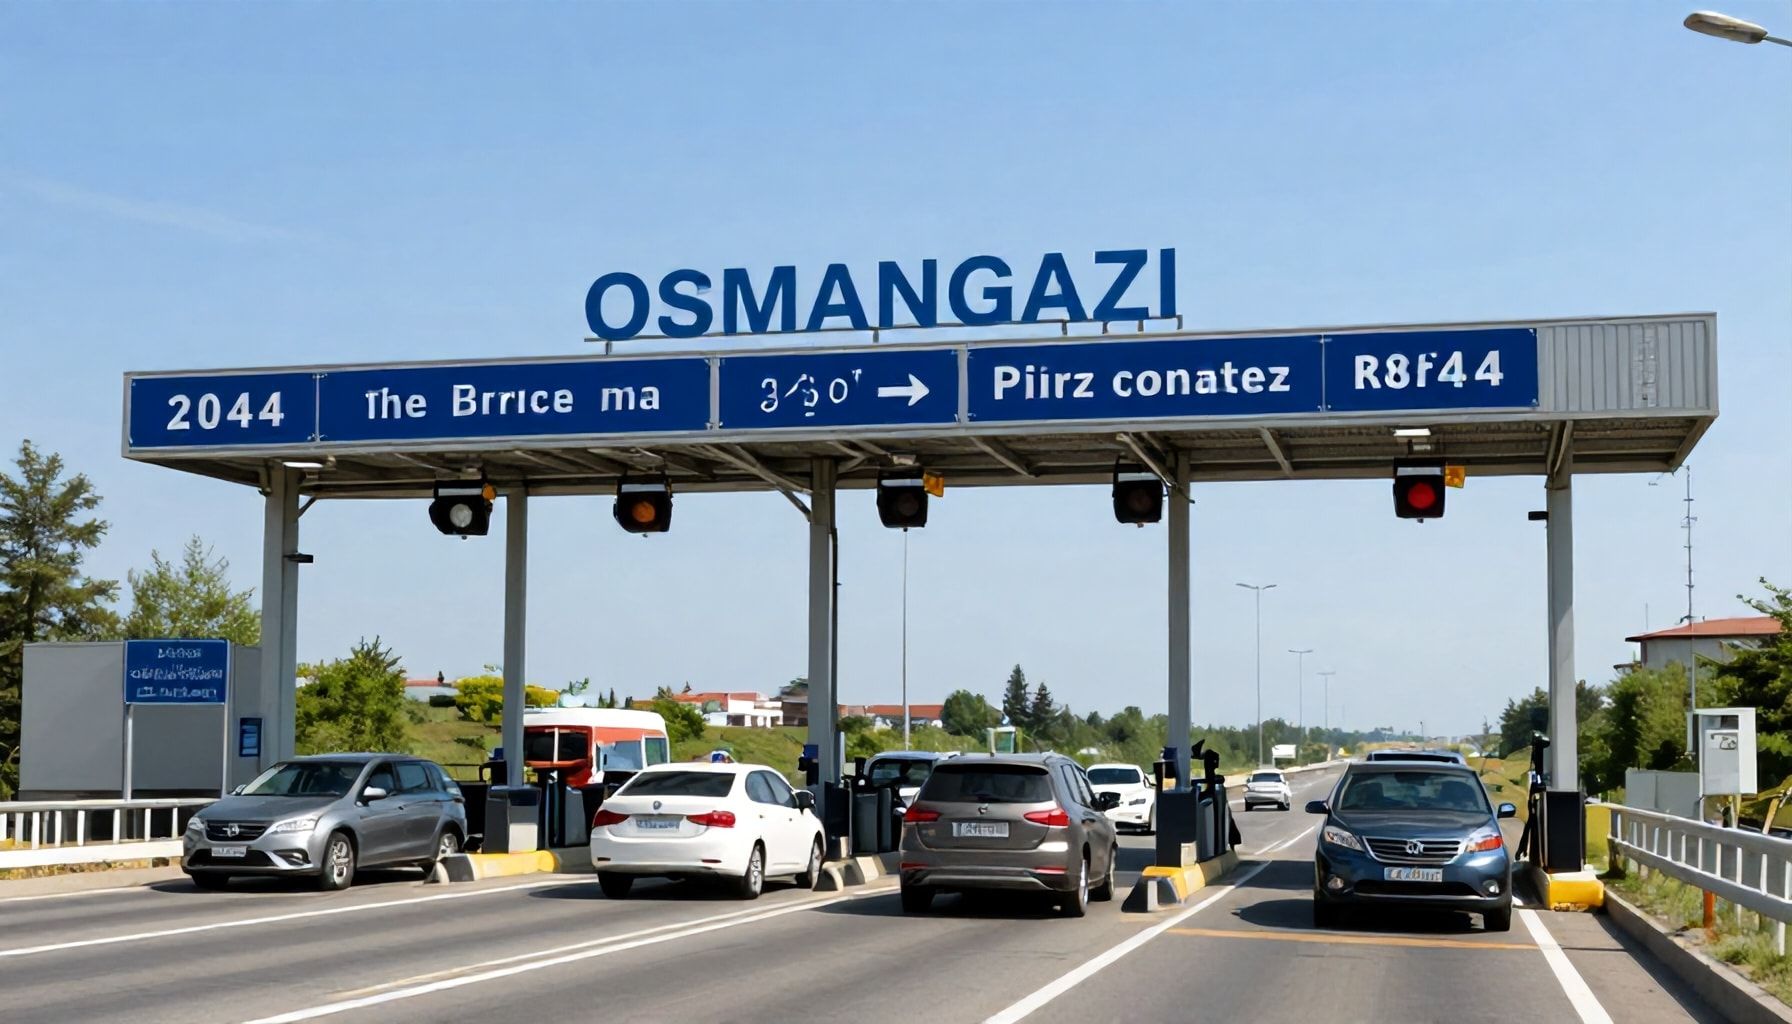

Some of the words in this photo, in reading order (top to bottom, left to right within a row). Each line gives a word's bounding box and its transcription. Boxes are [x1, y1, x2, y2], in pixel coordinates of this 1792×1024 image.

[585, 248, 1176, 340] OSMANGAZI
[1112, 361, 1290, 398] conatez
[167, 391, 285, 430] 2044
